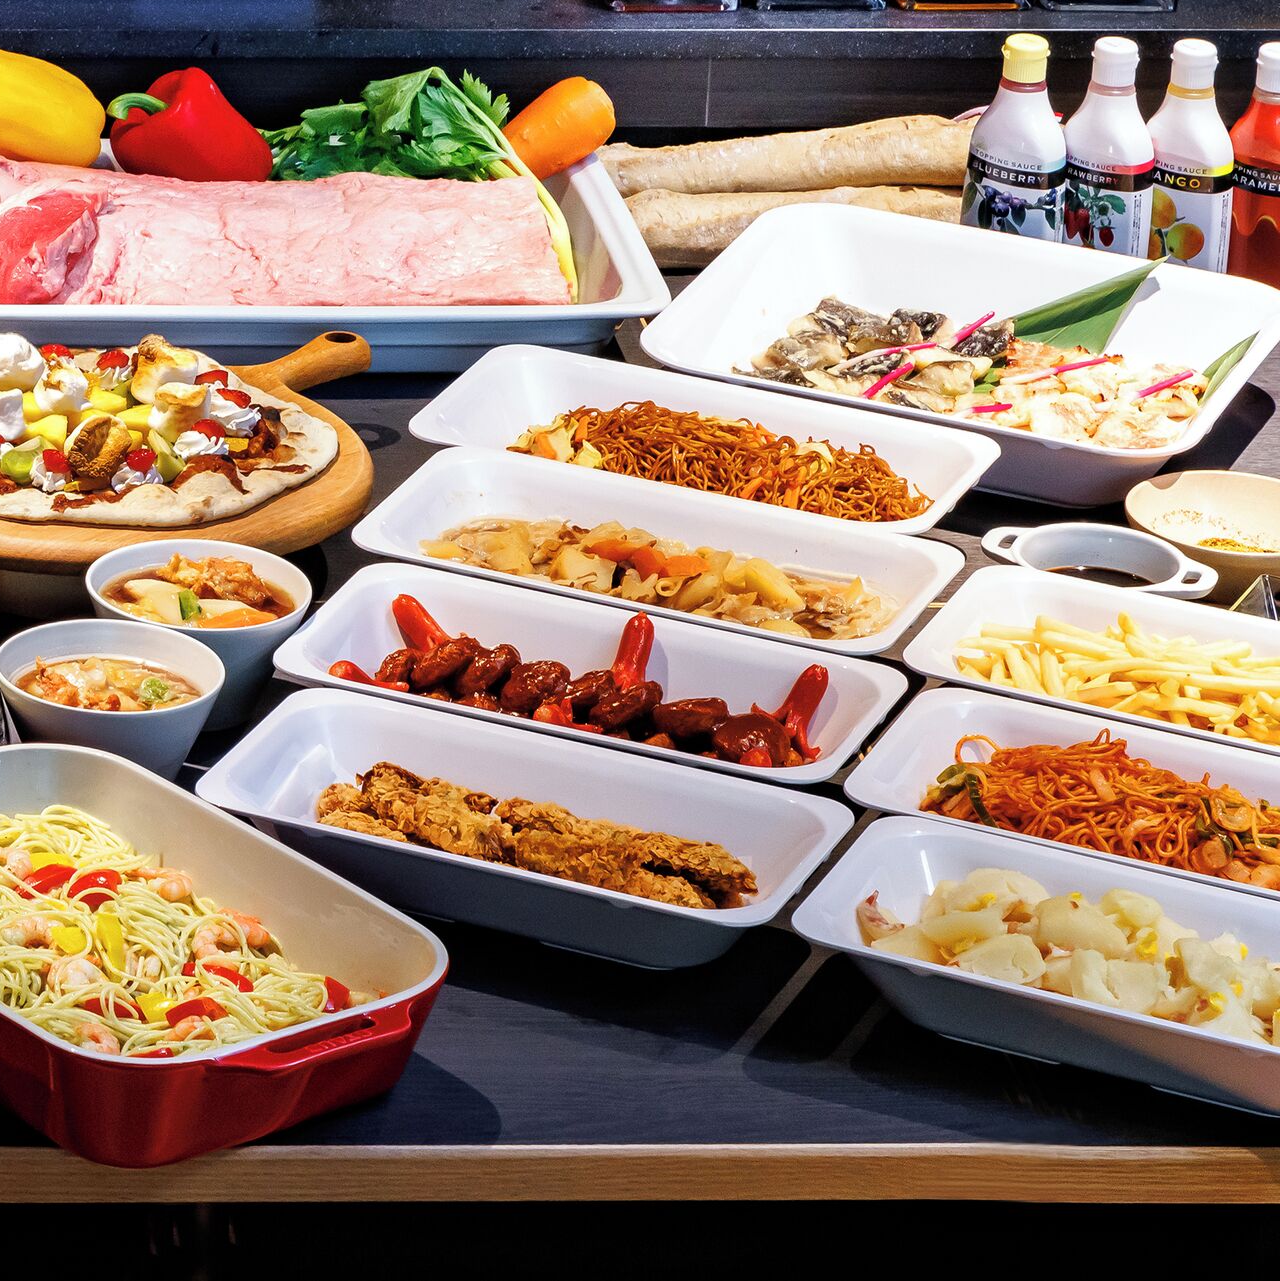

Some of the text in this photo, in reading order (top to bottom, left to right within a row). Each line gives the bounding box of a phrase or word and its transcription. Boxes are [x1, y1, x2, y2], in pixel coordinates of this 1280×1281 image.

[975, 148, 1042, 171] TOPPING SAUCE
[1091, 162, 1117, 172] SAUCE
[972, 160, 1045, 185] BLUEBERRY
[1177, 166, 1208, 175] SAUCE
[1260, 172, 1280, 181] SAU
[1152, 169, 1201, 189] ANGO
